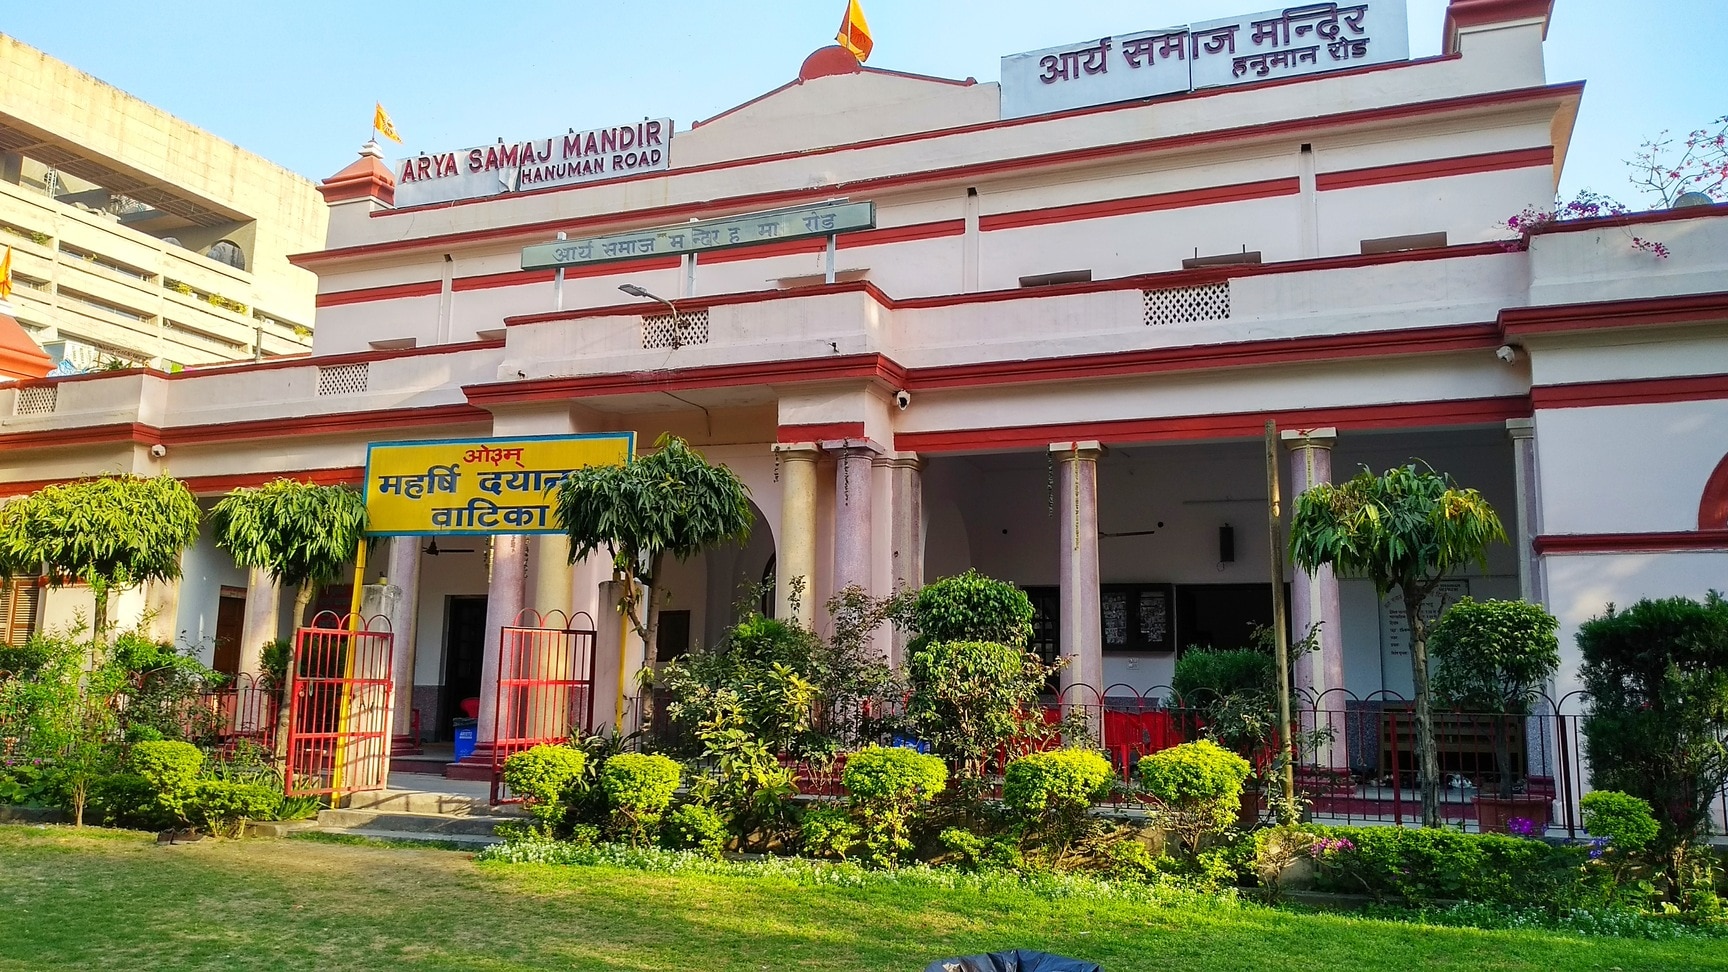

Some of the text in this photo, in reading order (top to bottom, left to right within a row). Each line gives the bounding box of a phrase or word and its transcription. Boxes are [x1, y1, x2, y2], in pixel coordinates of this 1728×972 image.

[1040, 2, 1369, 84] आर्य समाज मन्दिर
[1232, 36, 1371, 79] हनुमान रोड
[401, 120, 662, 184] ARYA SAMAJ MANDIR
[521, 149, 662, 184] HANUMAN ROAD
[552, 241, 594, 263] आर्य
[602, 237, 656, 258] समाज
[802, 211, 838, 233] रोड
[378, 464, 462, 499] महर्षि
[431, 497, 550, 527] वाटिका
